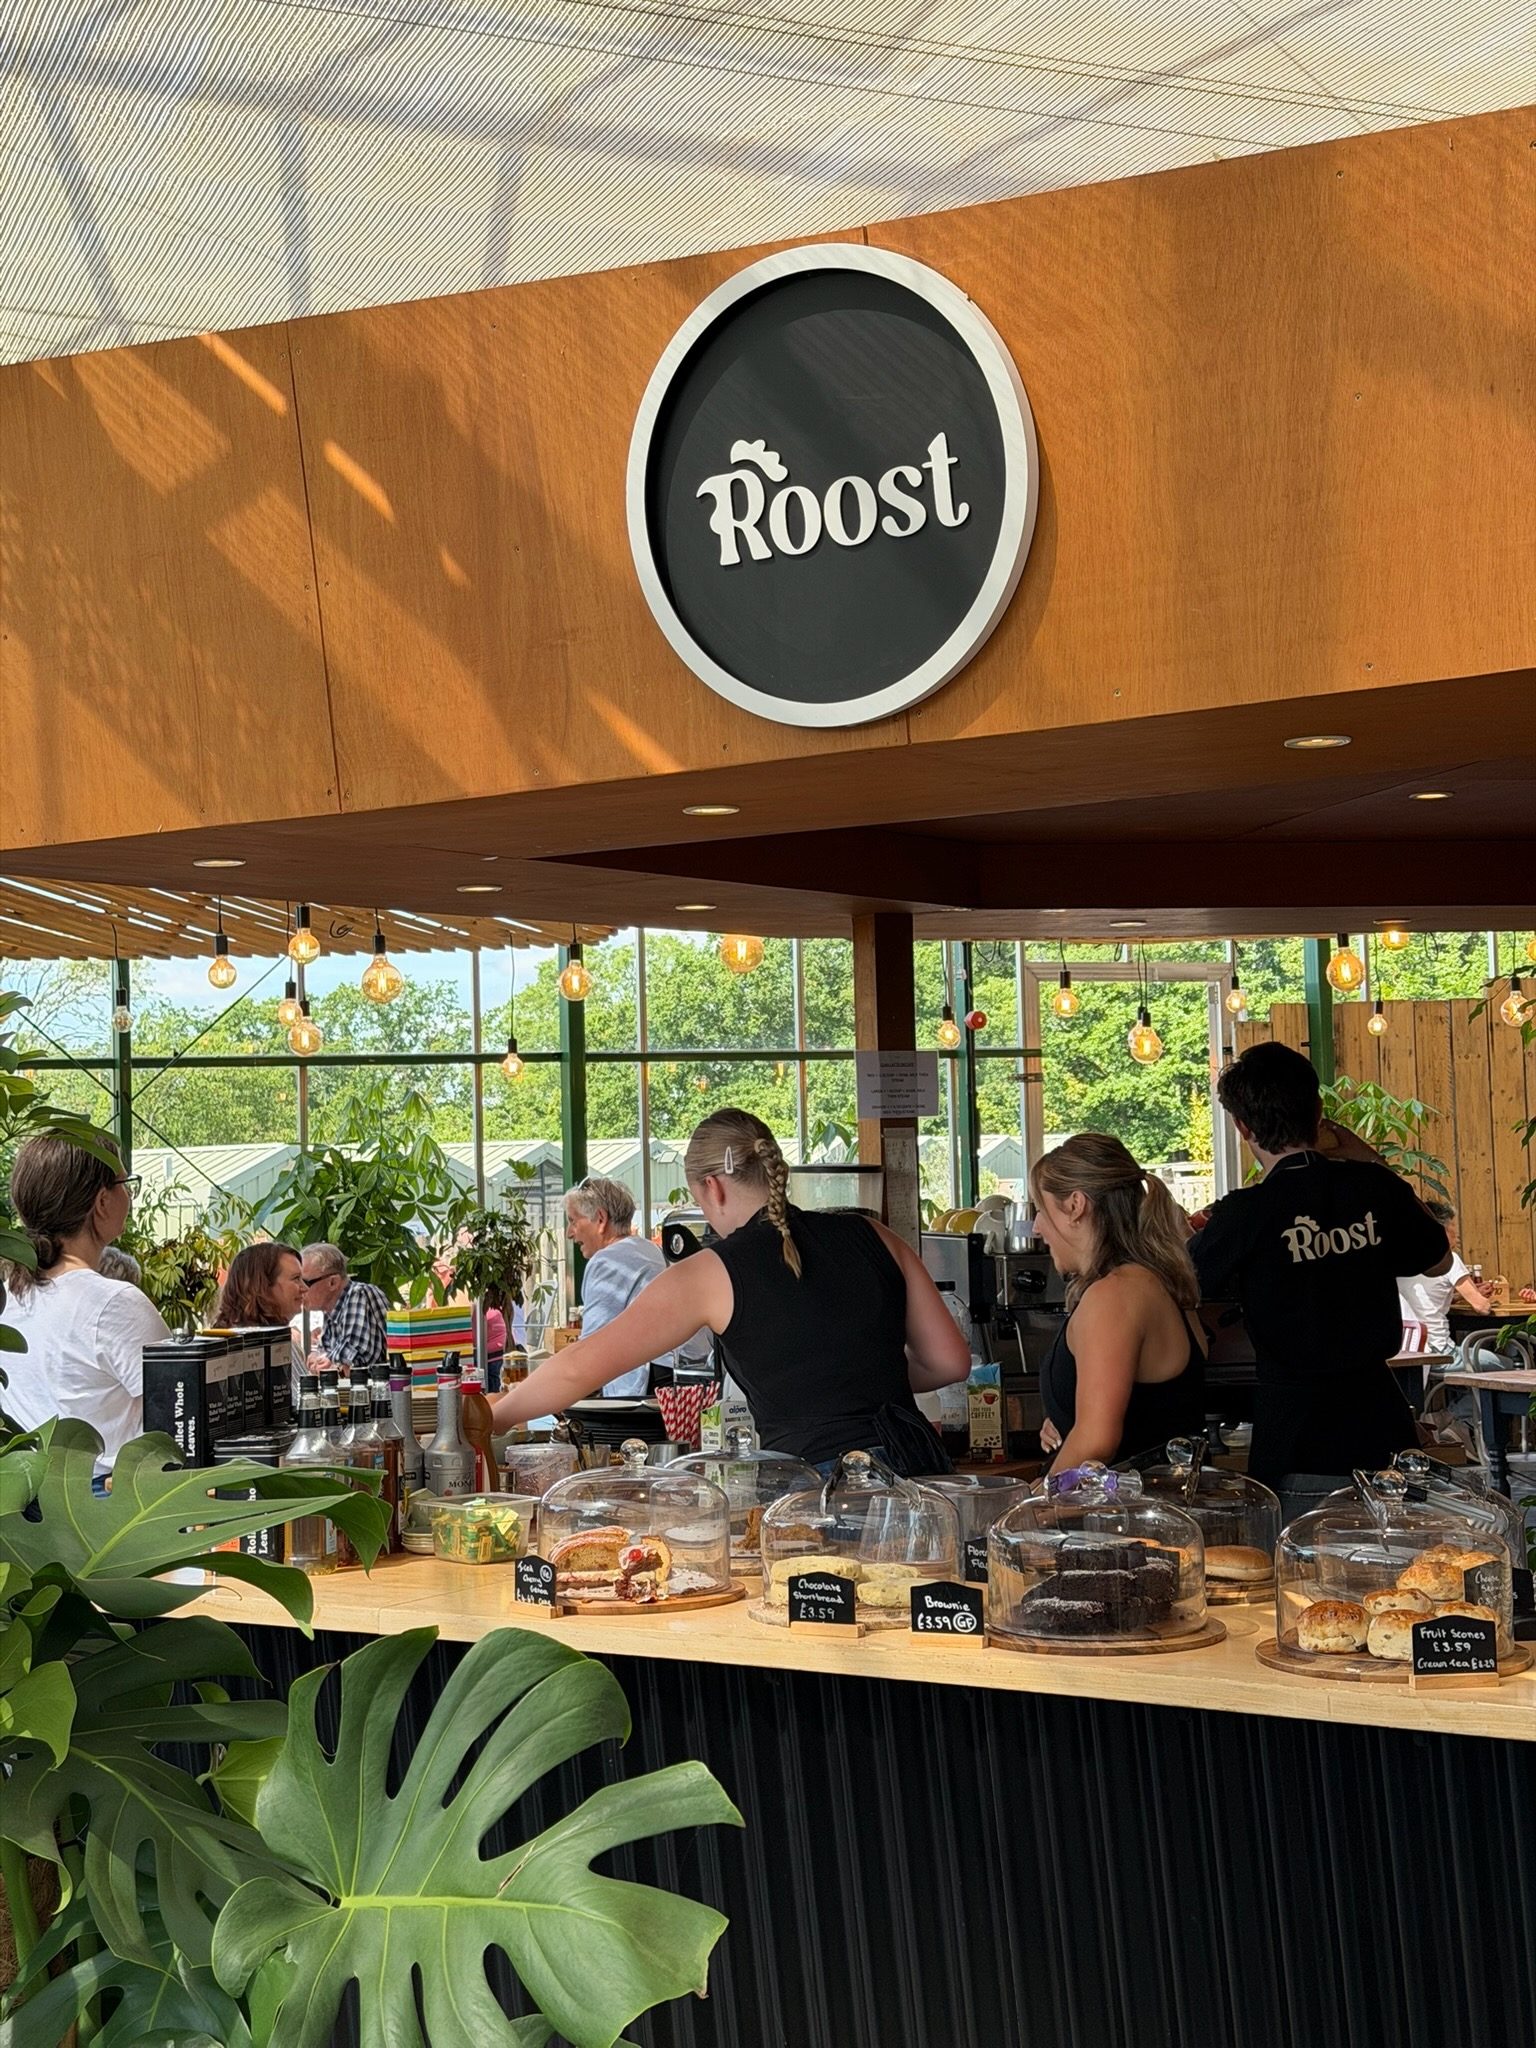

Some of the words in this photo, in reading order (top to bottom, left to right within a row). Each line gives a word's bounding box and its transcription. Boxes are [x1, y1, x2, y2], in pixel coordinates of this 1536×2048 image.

[696, 432, 970, 566] Roost
[1280, 1210, 1382, 1263] Roost
[174, 1381, 184, 1419] Whole
[186, 1416, 196, 1457] Leaves.
[798, 1578, 842, 1593] Chocolate
[793, 1590, 845, 1604] Shortbread
[924, 1595, 971, 1611] Brownie
[799, 1602, 836, 1620] £3.59
[917, 1612, 952, 1631] £3.59
[956, 1615, 974, 1630] GF
[1420, 1627, 1446, 1639] Fruit
[1450, 1628, 1486, 1640] Scones
[1417, 1657, 1448, 1669] Cream
